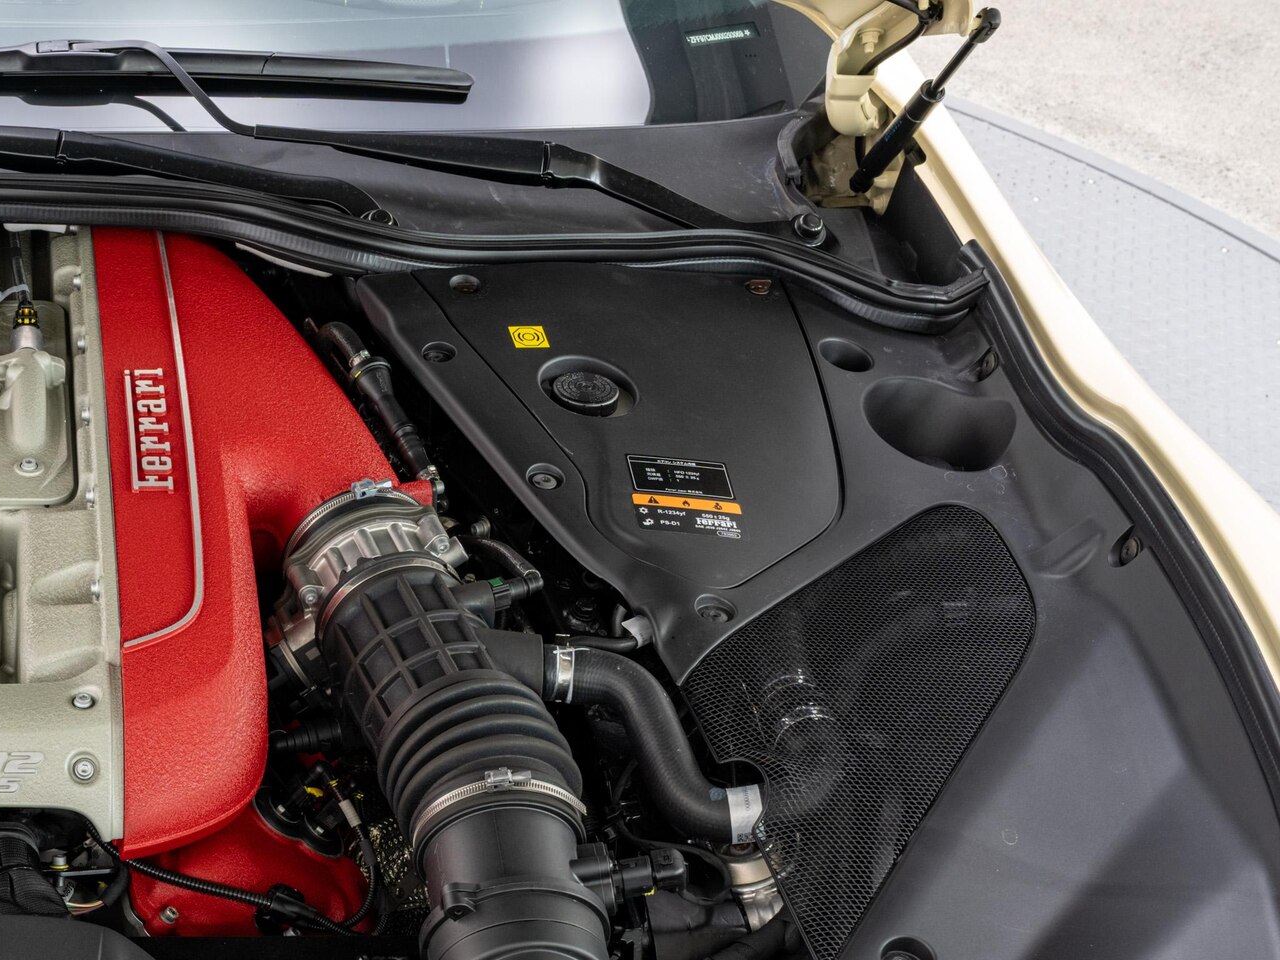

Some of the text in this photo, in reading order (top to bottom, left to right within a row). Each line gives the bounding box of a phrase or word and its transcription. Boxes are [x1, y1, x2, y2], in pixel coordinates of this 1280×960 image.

[123, 367, 174, 493] Ferrari
[657, 509, 686, 517] R-1234yf
[695, 517, 738, 529] Ferrari
